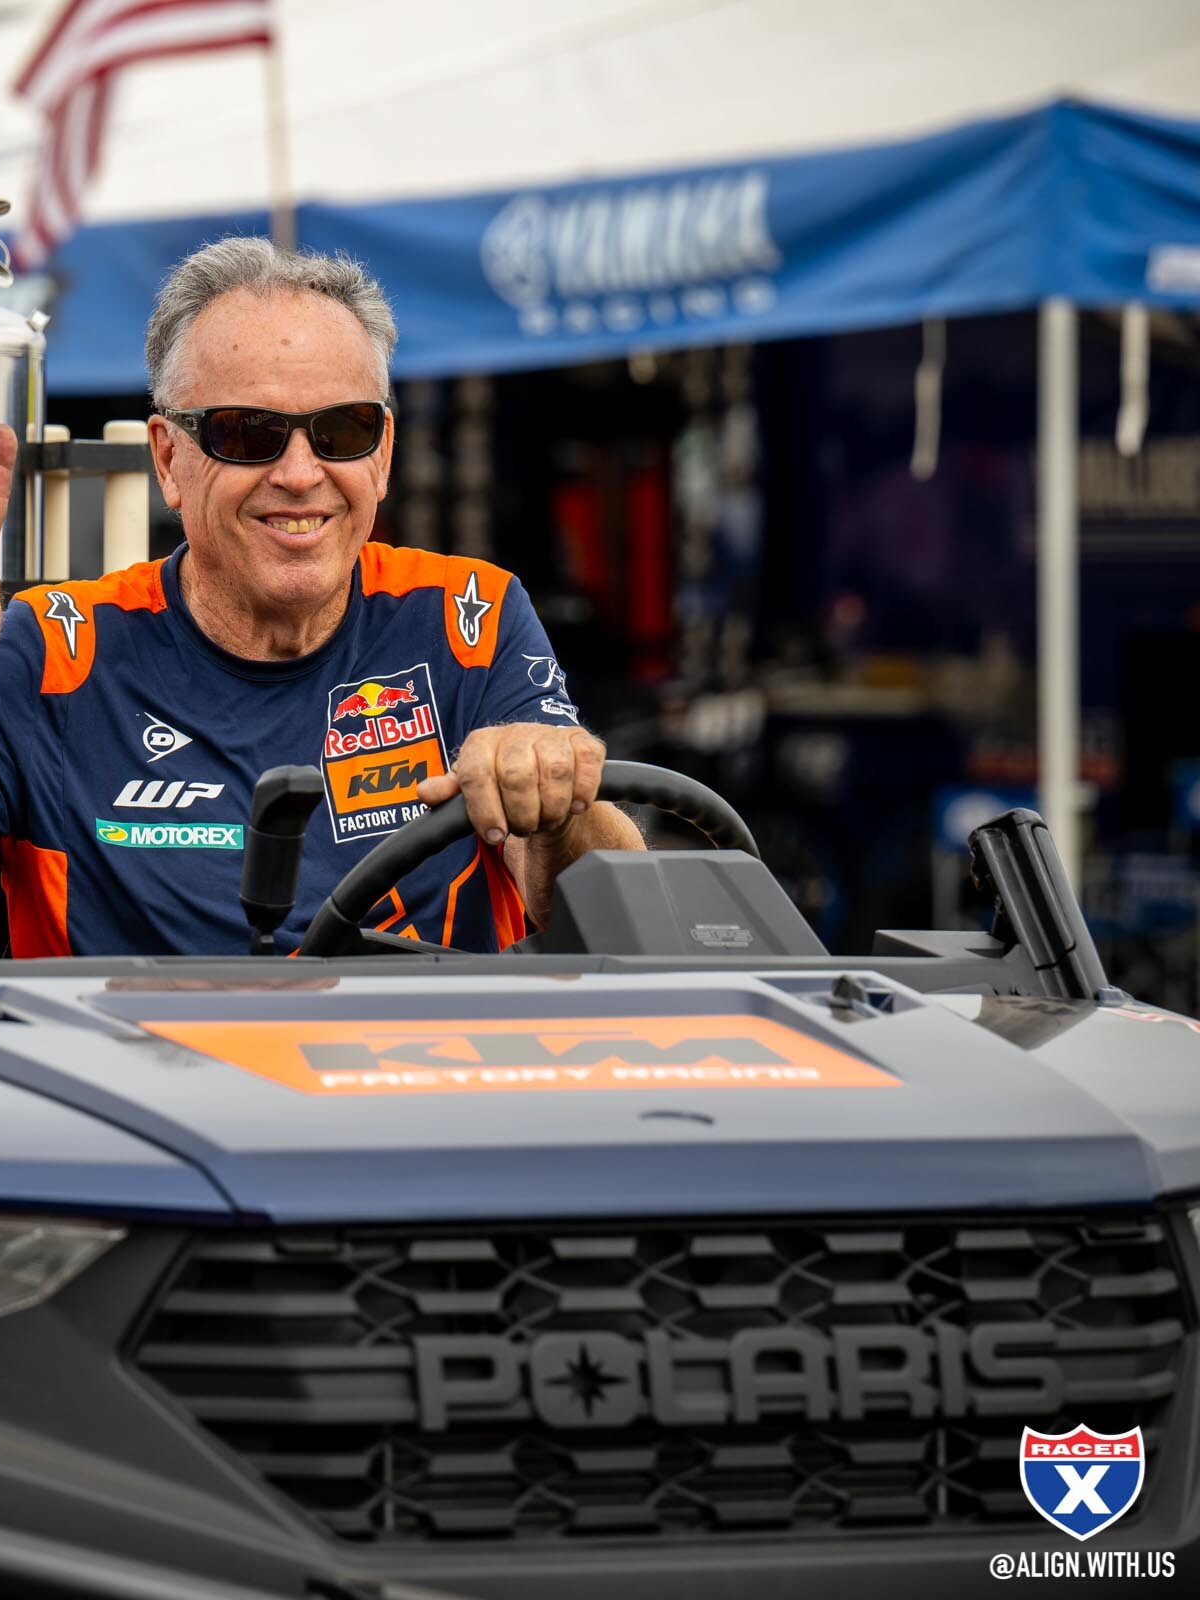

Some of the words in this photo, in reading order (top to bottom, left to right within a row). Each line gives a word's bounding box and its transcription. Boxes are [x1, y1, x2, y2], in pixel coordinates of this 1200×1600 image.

[325, 718, 381, 758] Red
[377, 704, 435, 746] Bull
[113, 780, 225, 808] WP
[347, 760, 428, 798] KTM
[339, 808, 402, 833] FACTORY
[402, 803, 432, 823] RAC
[131, 826, 238, 846] MOTOREX
[297, 1030, 797, 1072] KTM
[321, 1068, 593, 1087] FACTORY
[612, 1067, 821, 1080] RACING
[413, 1322, 1063, 1430] POLARIS
